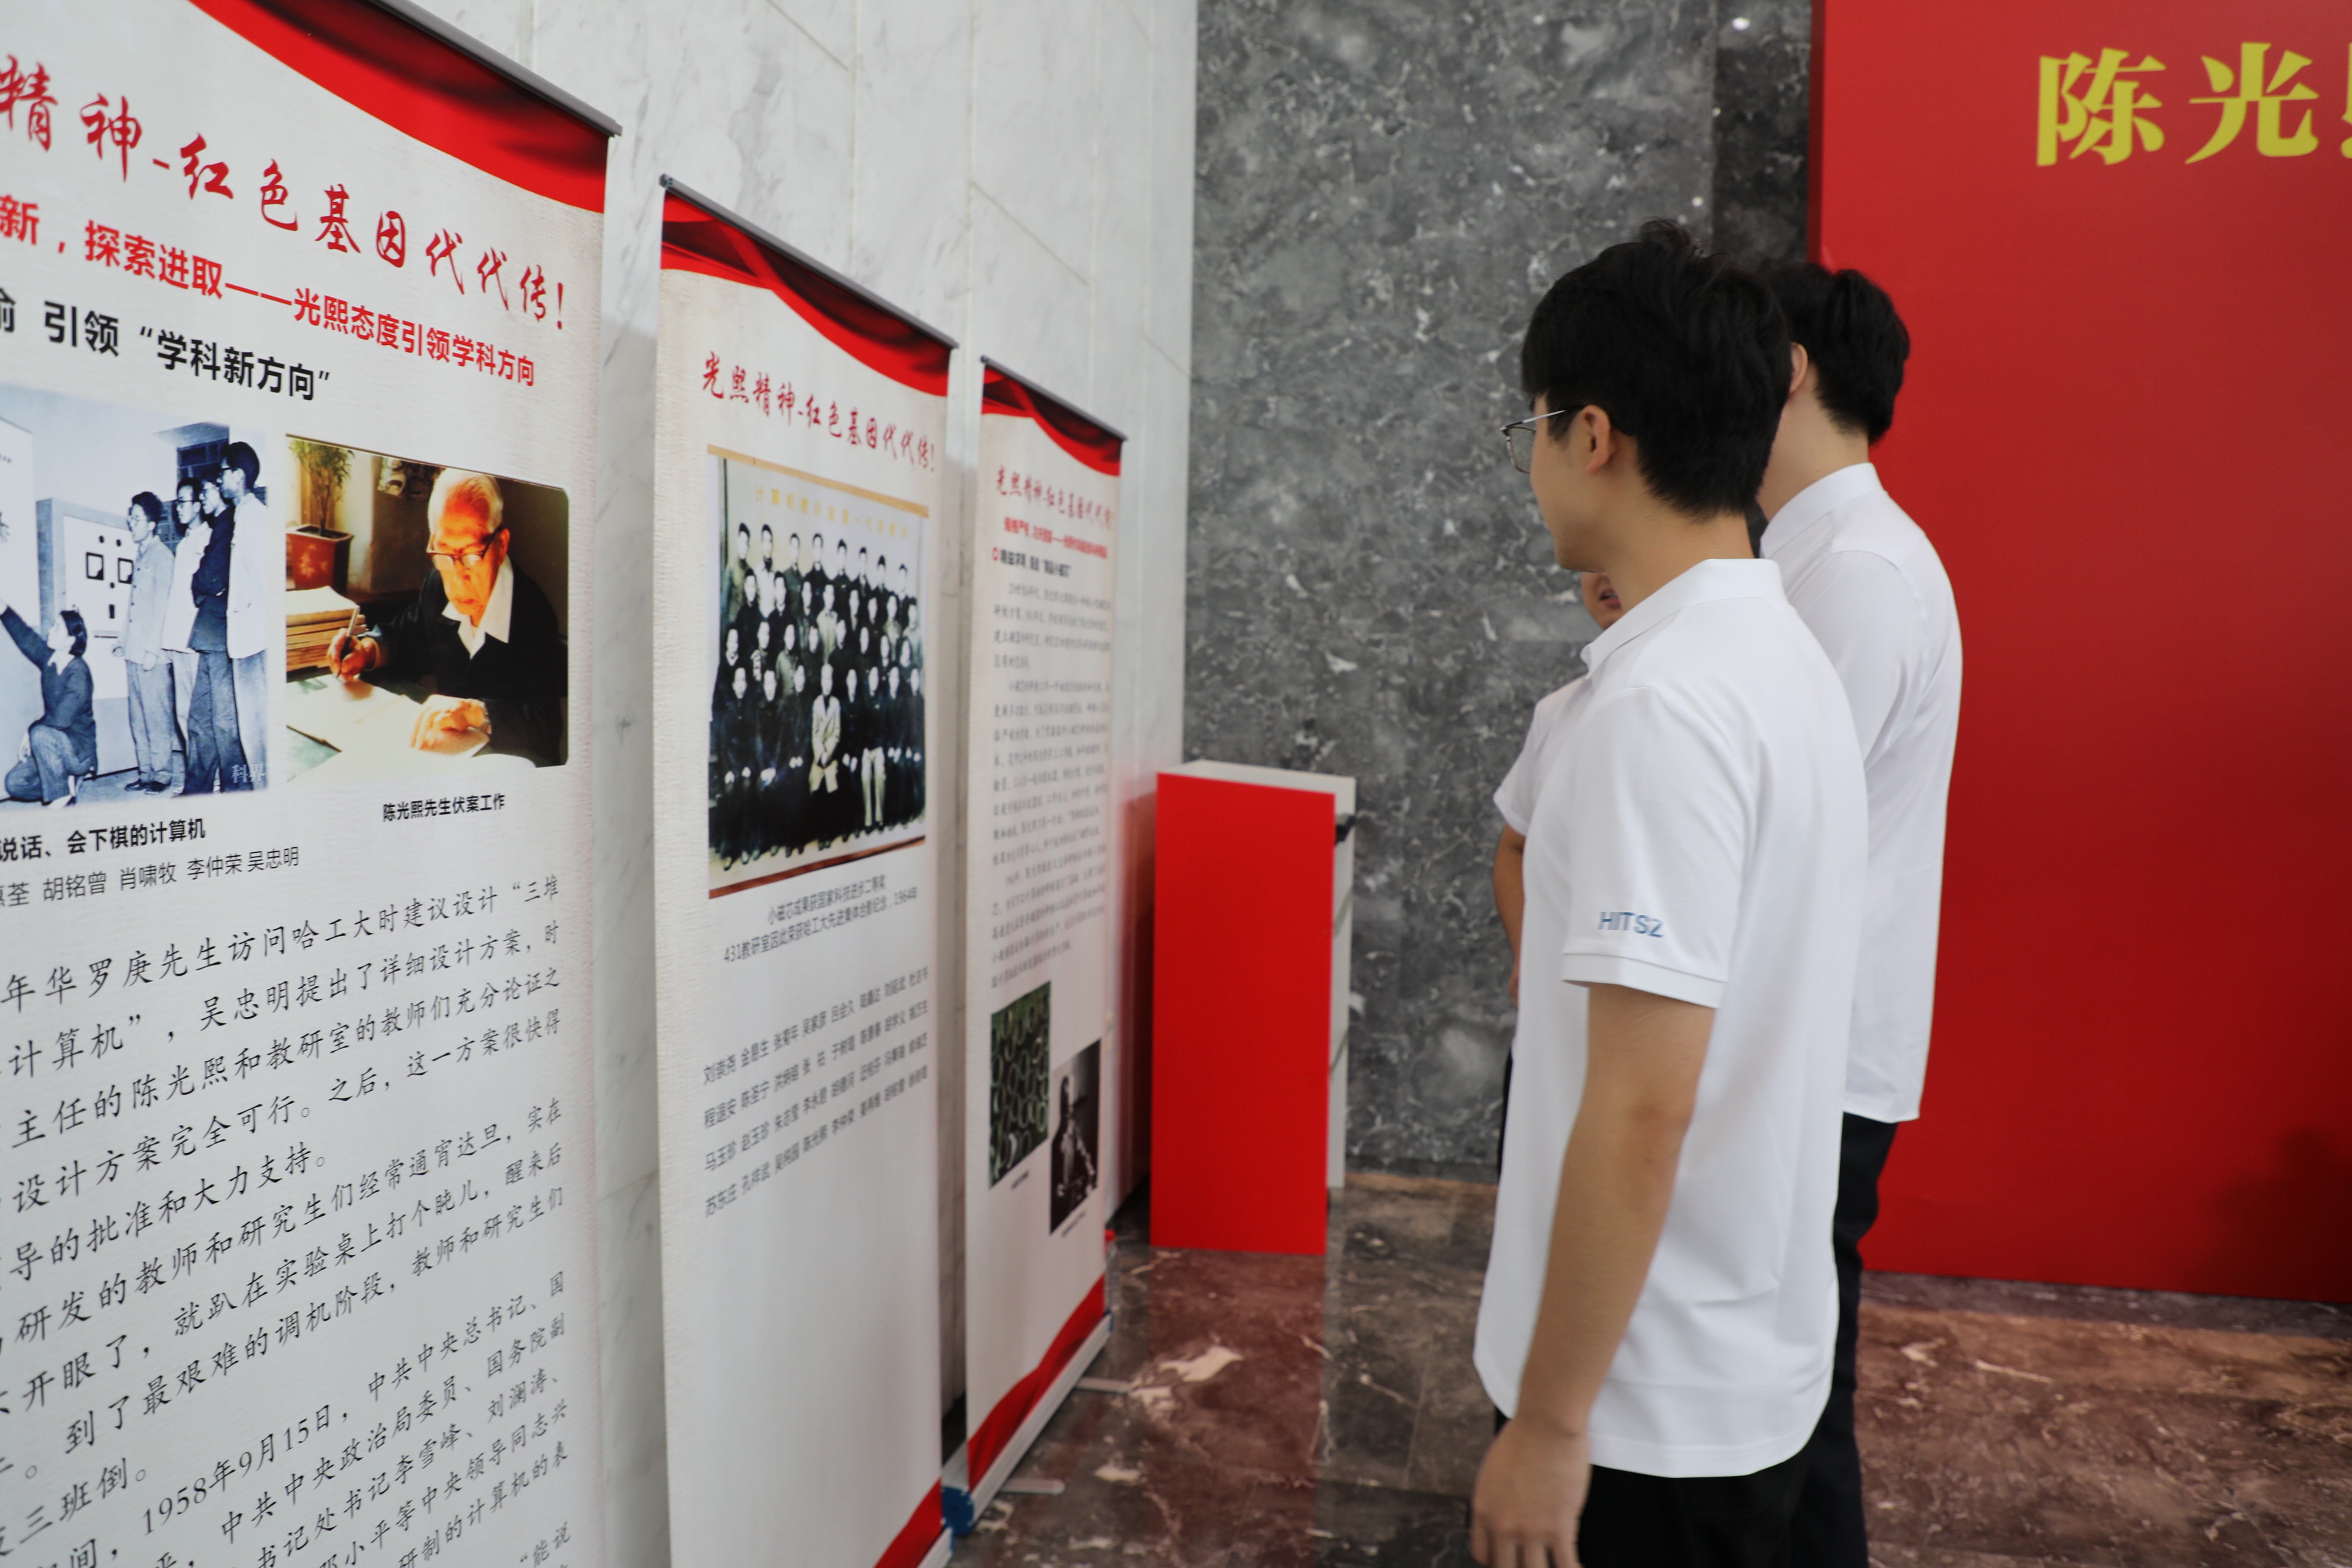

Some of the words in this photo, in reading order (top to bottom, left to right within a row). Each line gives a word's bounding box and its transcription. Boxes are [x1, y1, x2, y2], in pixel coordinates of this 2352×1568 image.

[2036, 41, 2352, 167] 陈光
[382, 793, 505, 822] 陈光熙先生伏案工作
[43, 872, 106, 902] 胡铭曾
[187, 853, 243, 880] 李仲荣
[247, 846, 299, 873] 吴忠明
[0, 1142, 562, 1414] 开眼了，就趴在实验桌上打个盹儿，醒来后
